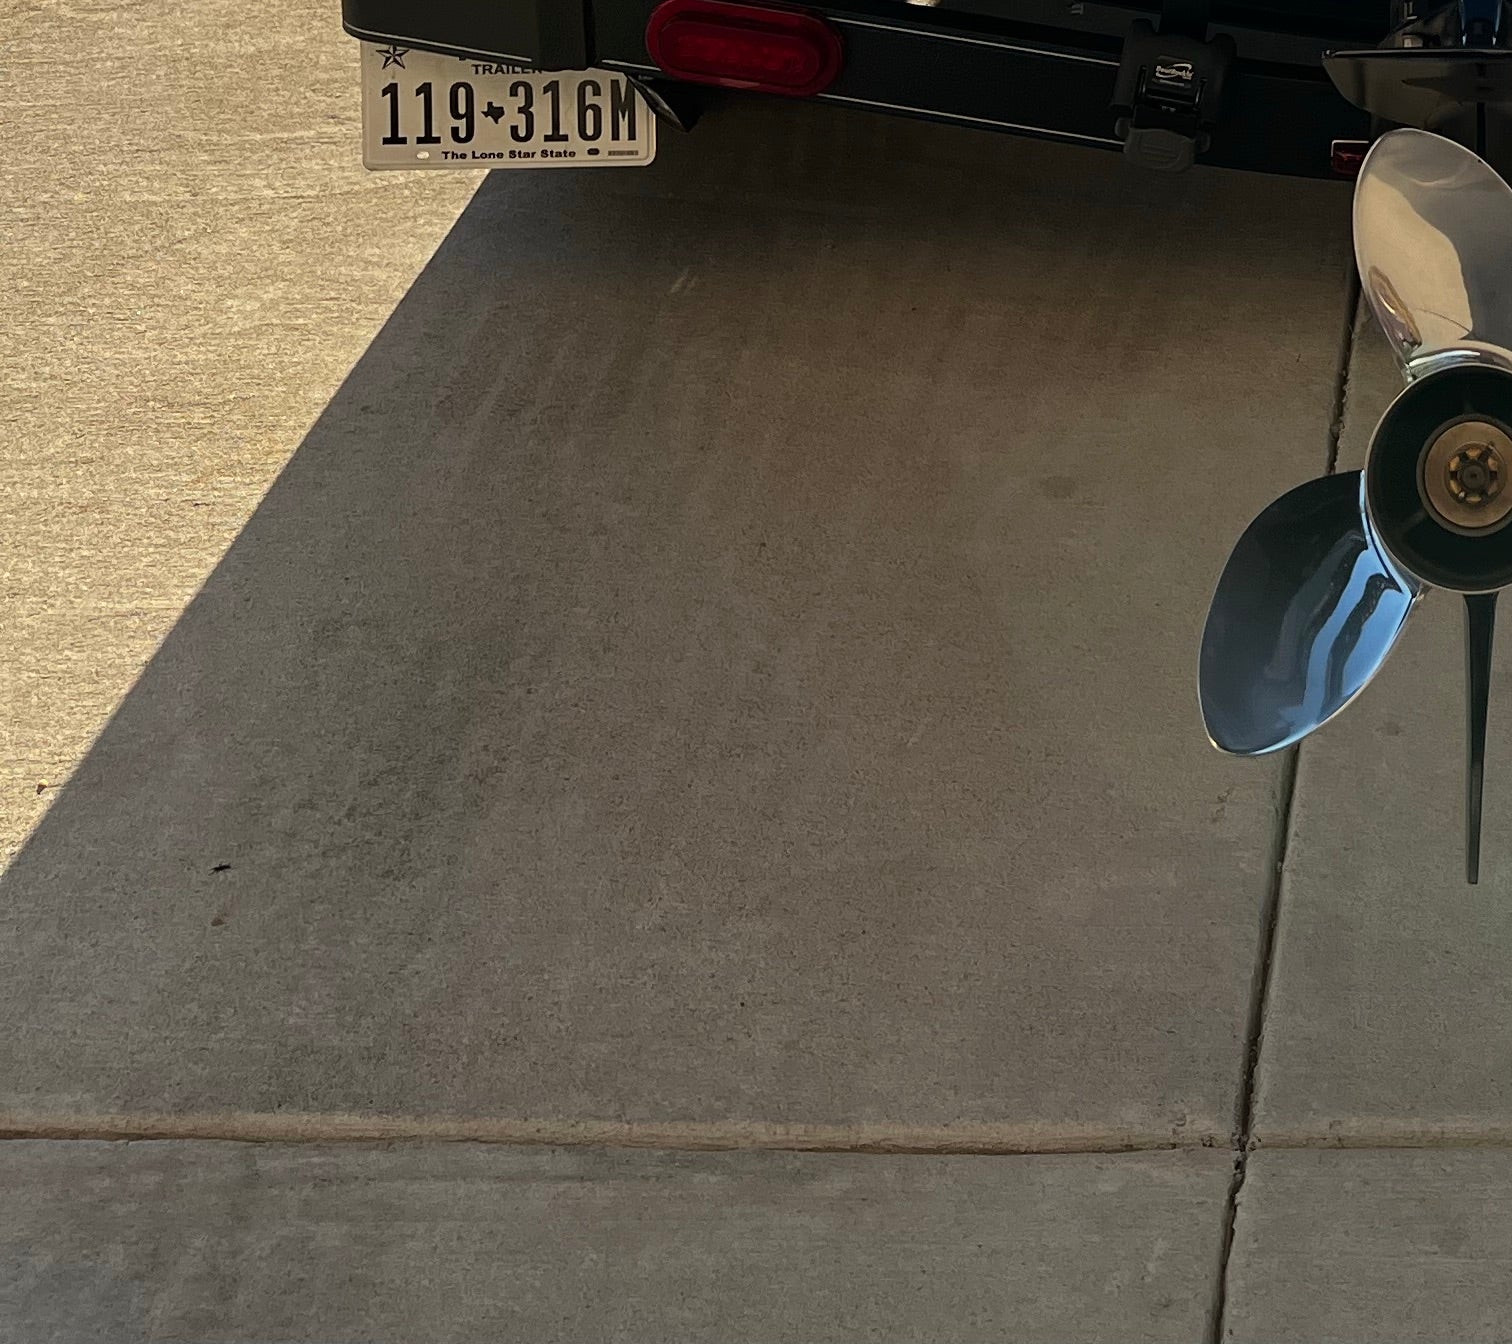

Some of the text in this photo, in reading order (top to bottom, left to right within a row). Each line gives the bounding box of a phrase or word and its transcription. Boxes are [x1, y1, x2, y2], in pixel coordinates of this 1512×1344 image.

[381, 79, 637, 146] 119 316M
[441, 149, 576, 160] The Lone Star State
